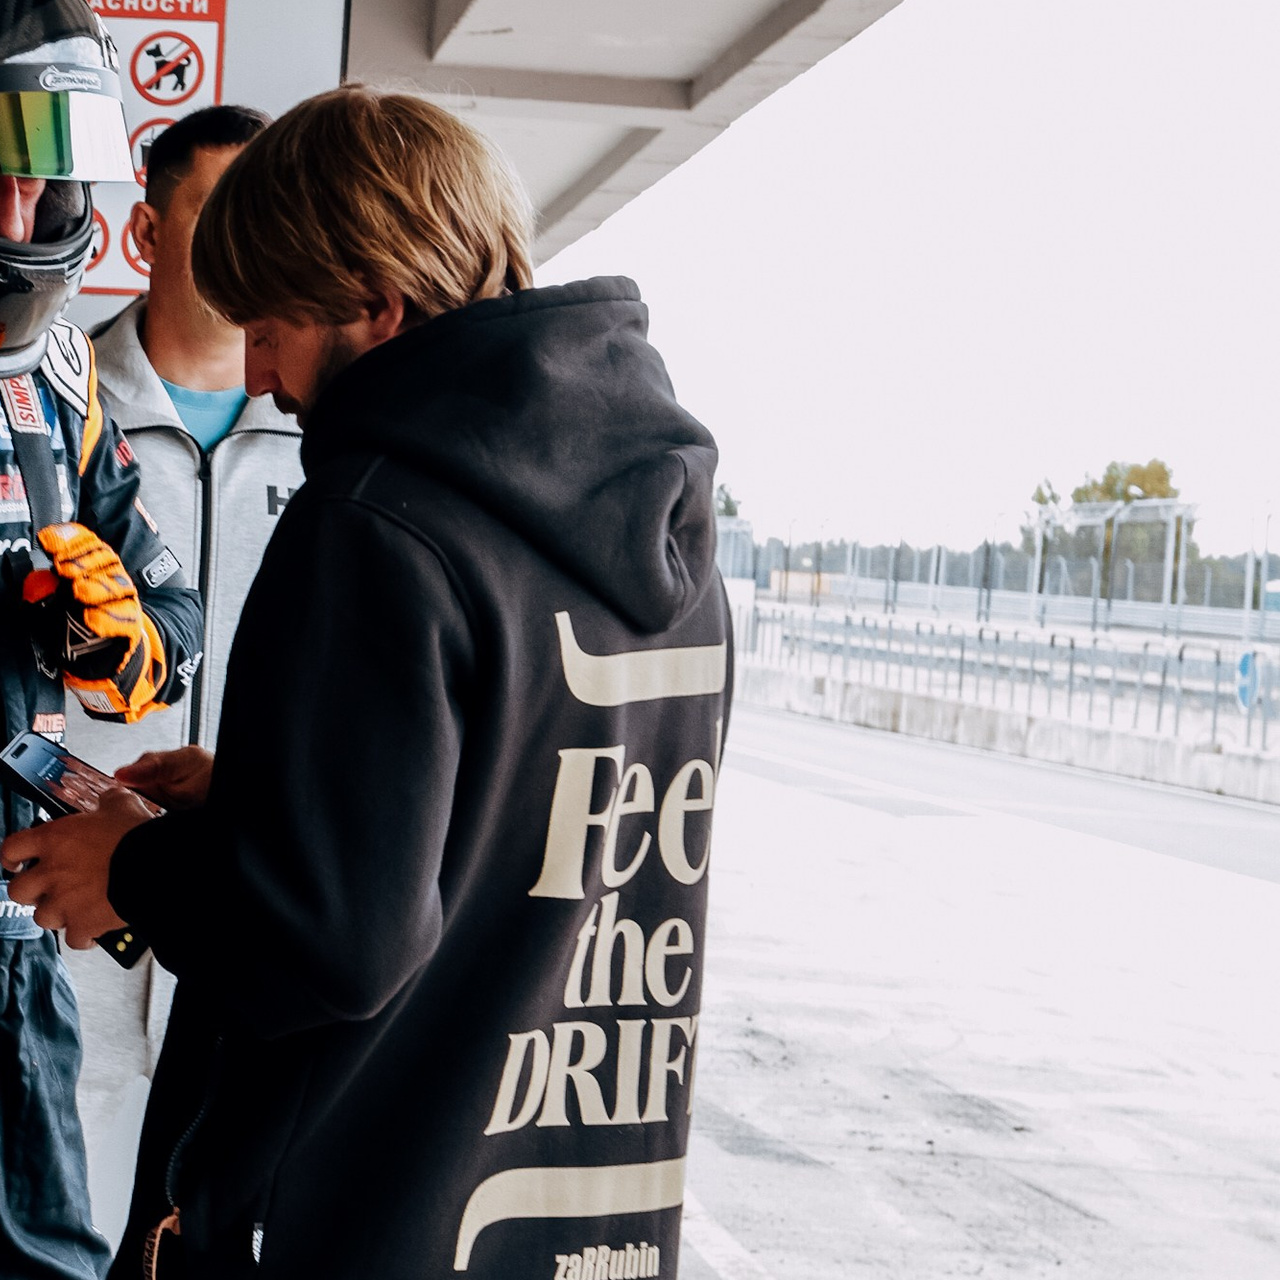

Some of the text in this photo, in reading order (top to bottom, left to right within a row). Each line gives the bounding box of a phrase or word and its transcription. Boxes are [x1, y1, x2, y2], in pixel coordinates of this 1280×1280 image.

[528, 720, 723, 900] Fee
[564, 891, 694, 1008] the
[483, 1014, 700, 1137] DRIF
